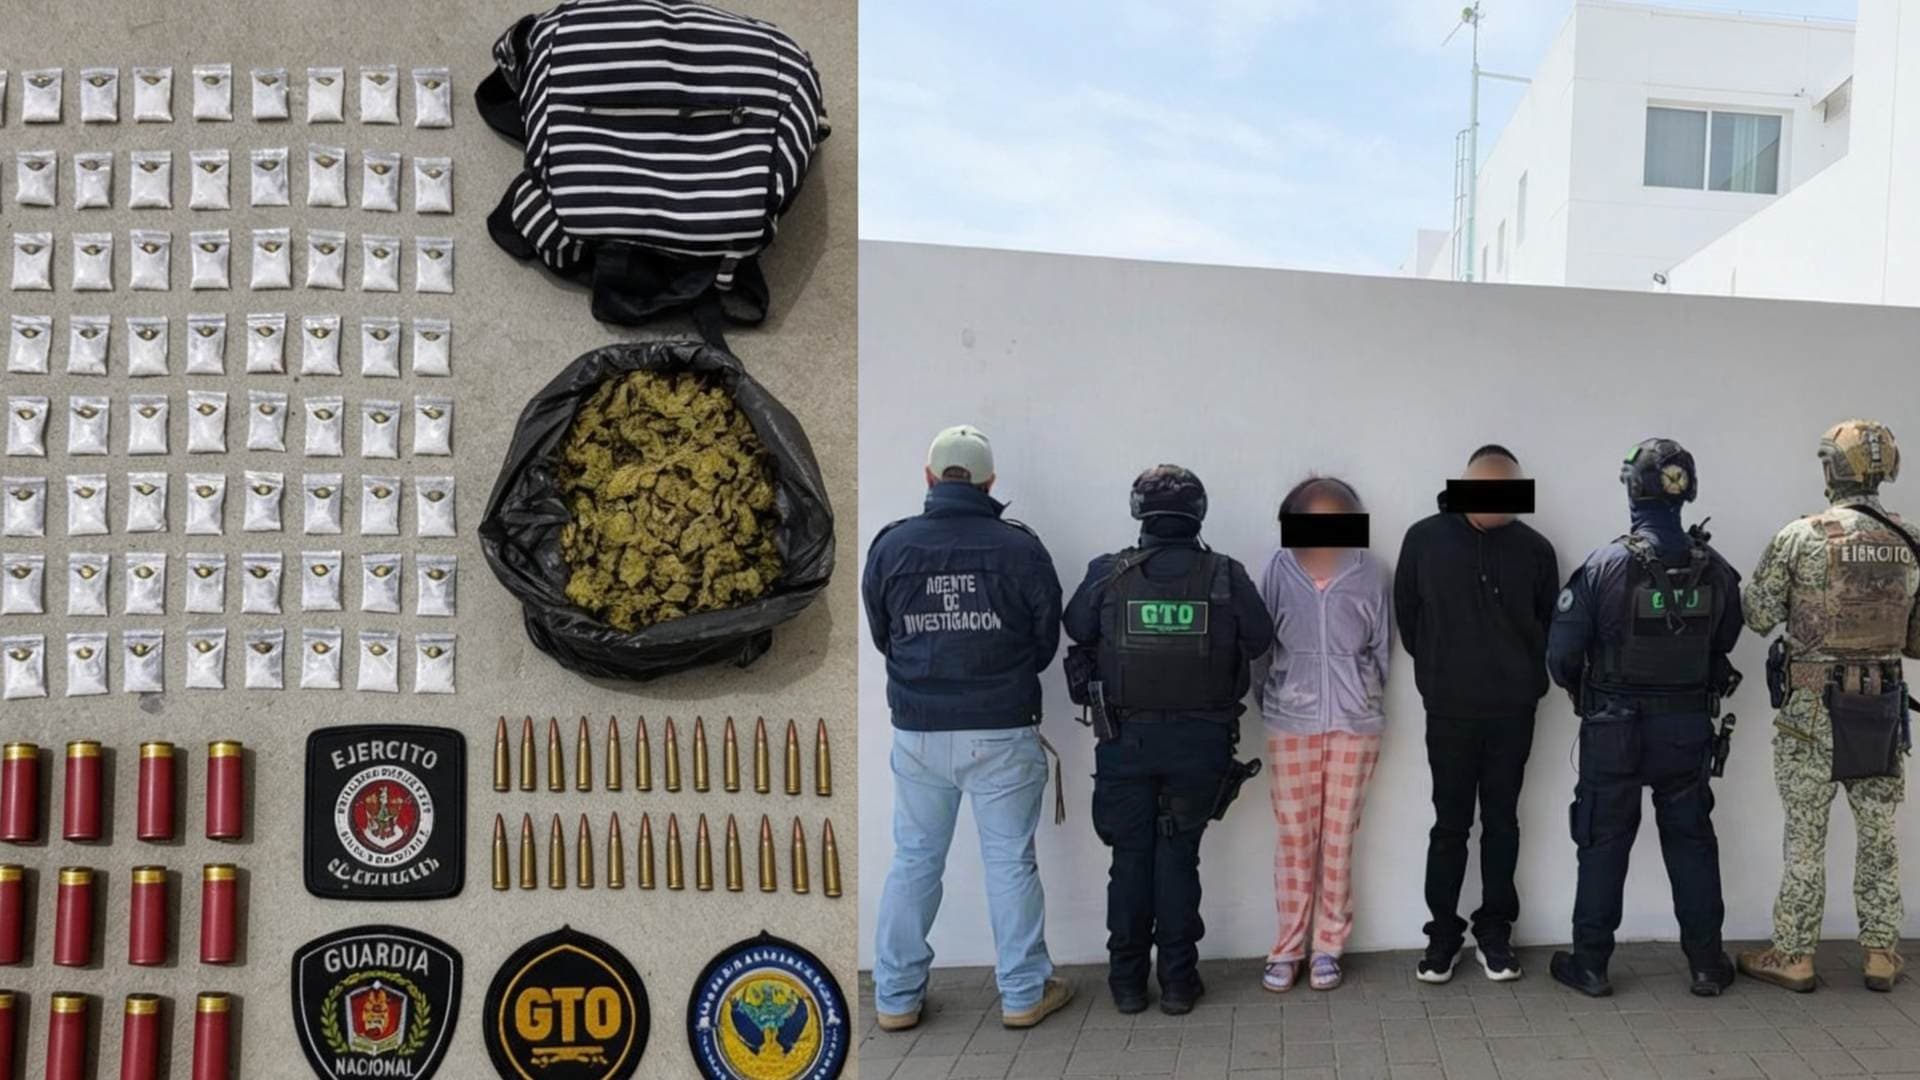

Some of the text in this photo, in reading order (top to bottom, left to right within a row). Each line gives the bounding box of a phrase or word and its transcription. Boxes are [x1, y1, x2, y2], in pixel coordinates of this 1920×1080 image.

[1141, 604, 1194, 624] GTO
[331, 740, 438, 770] EJERCITO
[324, 942, 429, 976] GUARDIA
[515, 986, 622, 1042] GTO
[335, 1056, 414, 1077] NACIONAL
